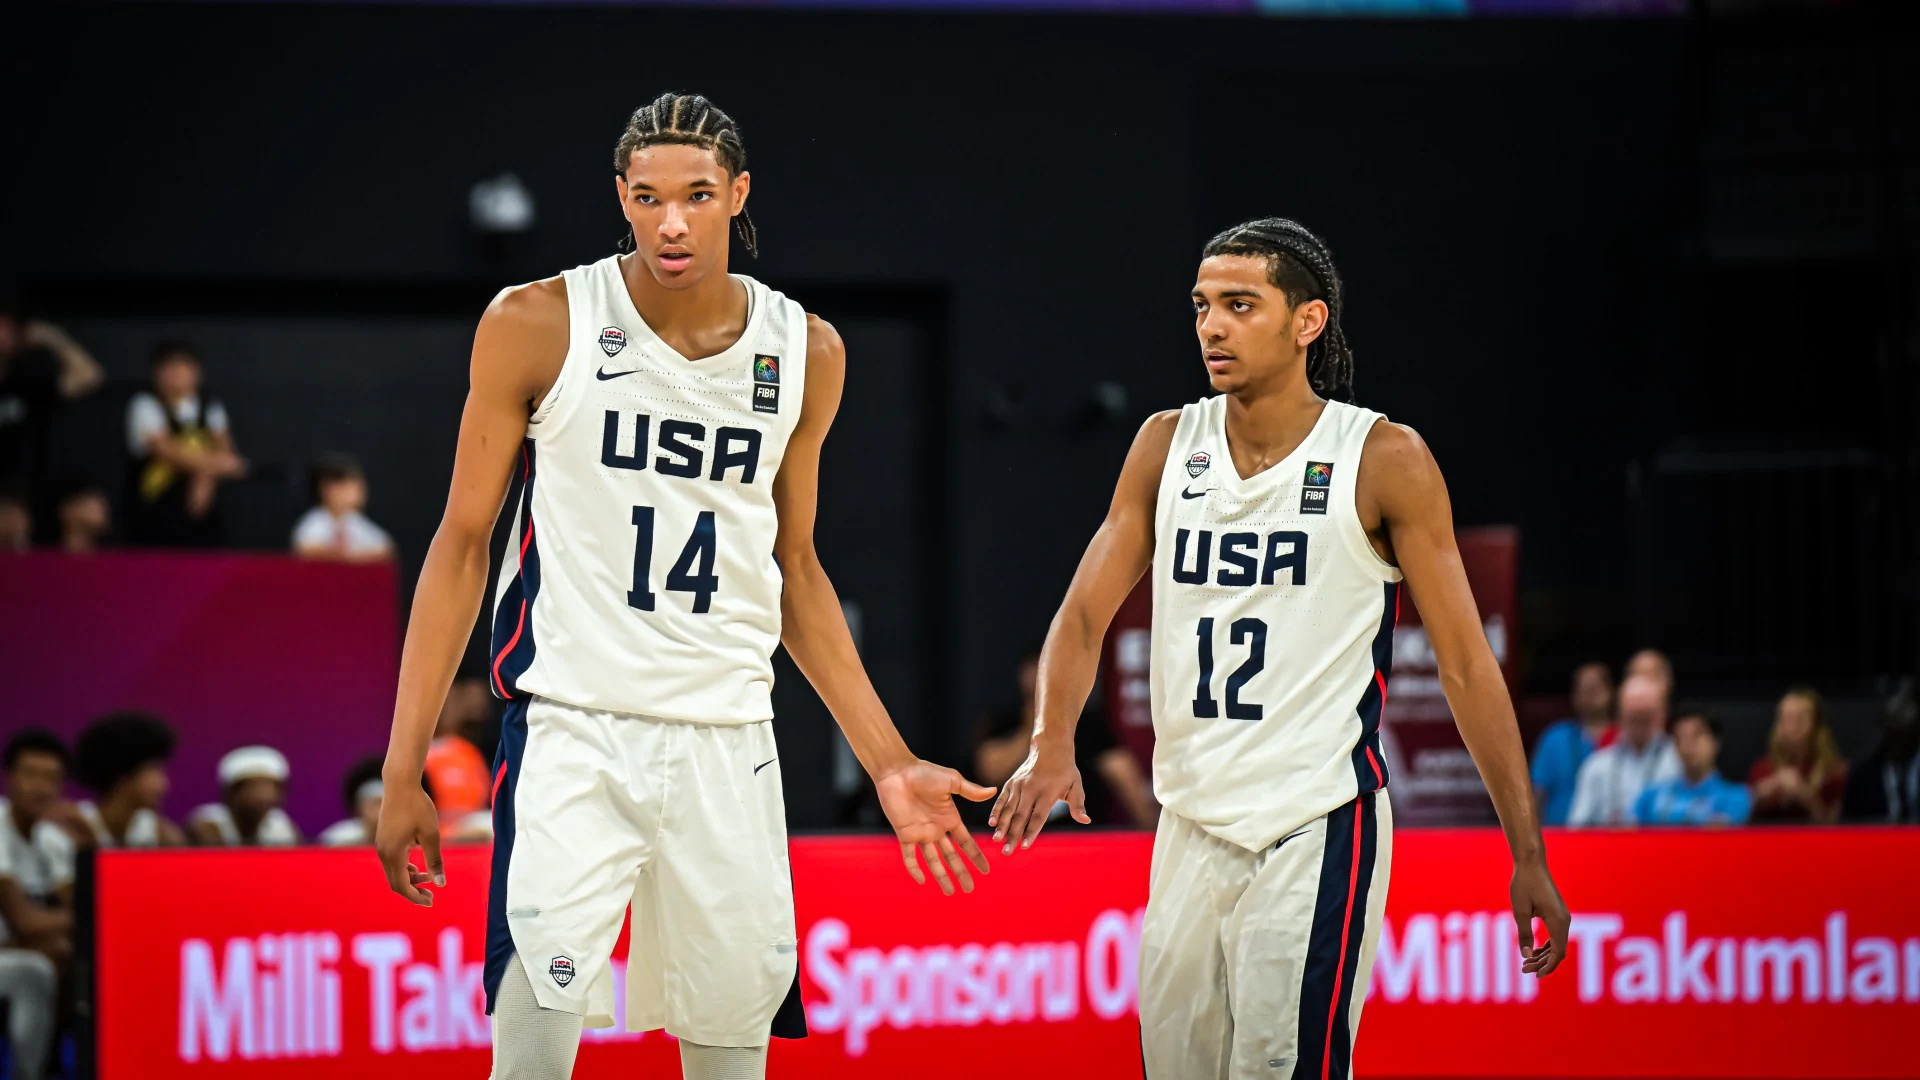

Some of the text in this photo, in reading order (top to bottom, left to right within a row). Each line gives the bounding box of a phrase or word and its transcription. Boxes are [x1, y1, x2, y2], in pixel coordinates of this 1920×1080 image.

[604, 330, 622, 340] USA
[757, 387, 776, 399] FIBA
[601, 410, 762, 484] USA
[1305, 490, 1325, 501] FIBA
[627, 505, 719, 613] 14
[1173, 528, 1308, 586] USA
[1192, 617, 1268, 720] 12
[179, 930, 342, 1063] Milli
[554, 960, 571, 970] USA
[806, 917, 1079, 1057] Sponsoru
